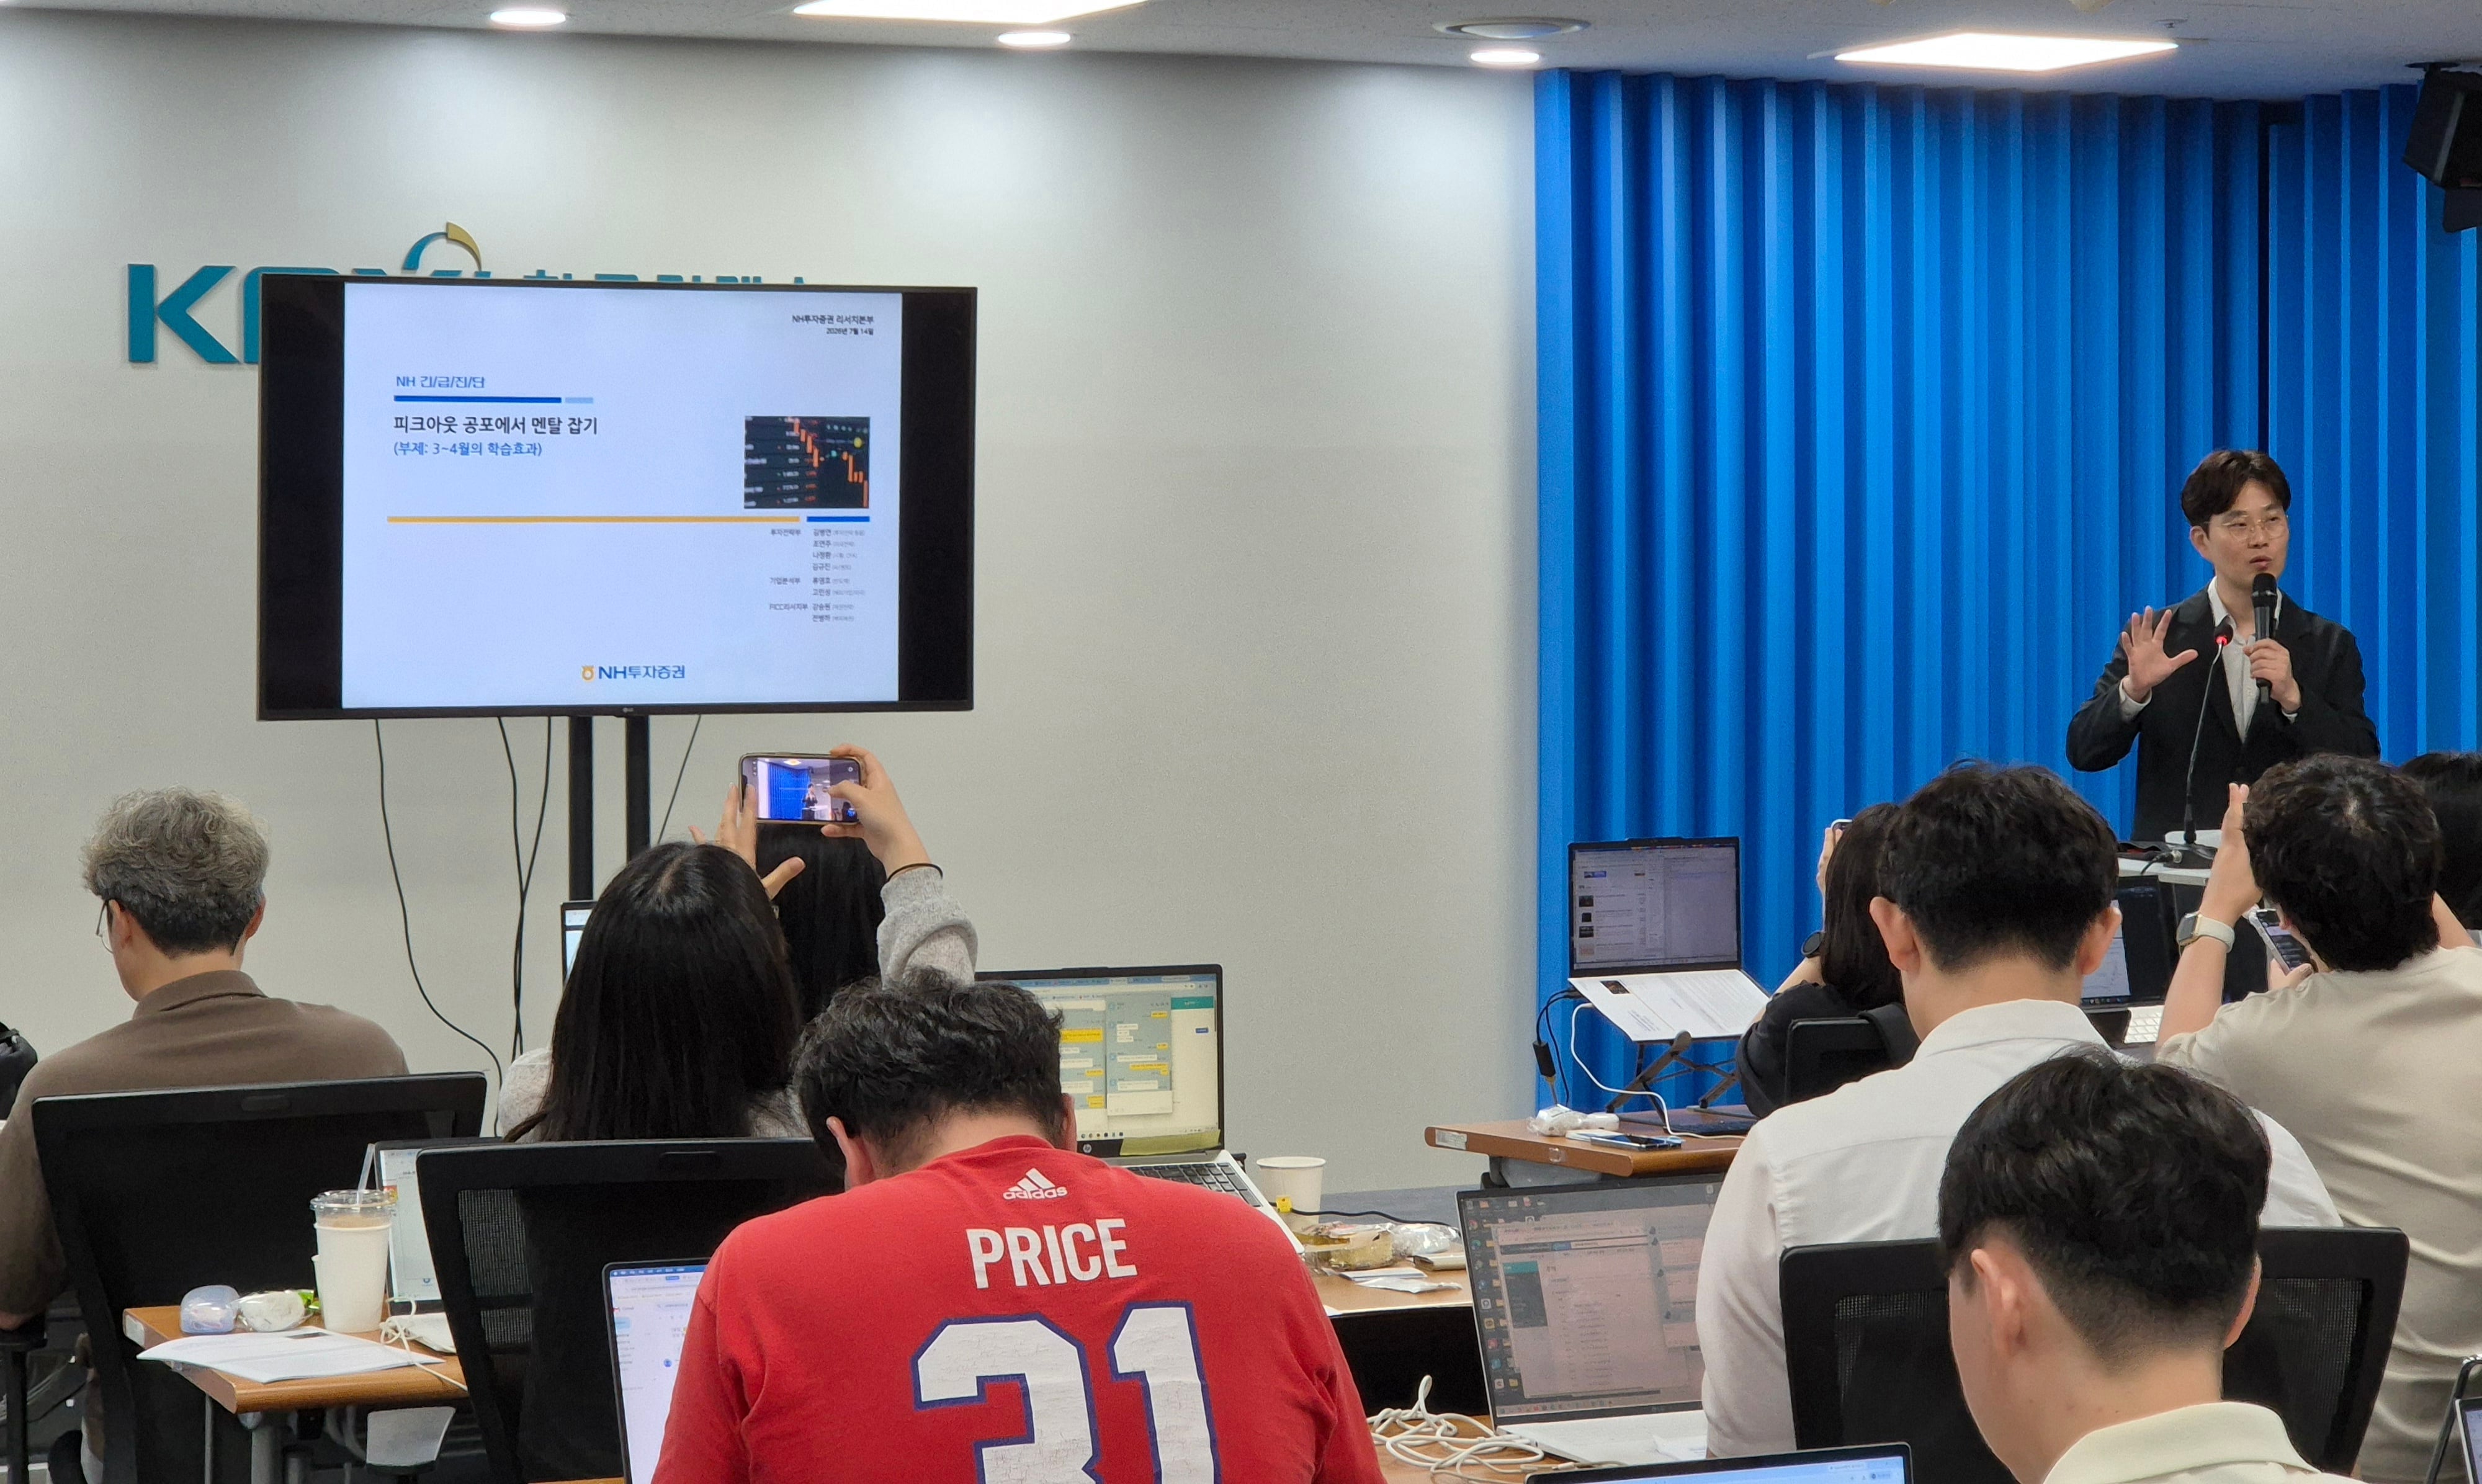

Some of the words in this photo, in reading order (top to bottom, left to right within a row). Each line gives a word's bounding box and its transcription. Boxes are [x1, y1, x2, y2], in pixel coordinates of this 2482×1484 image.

[792, 315, 834, 324] NH투자증권
[396, 376, 415, 387] NH
[420, 376, 485, 388] 긴/급/진/단
[393, 416, 459, 434] 피크아웃
[462, 416, 526, 434] 공포에서
[531, 417, 563, 435] 멘탈
[567, 417, 598, 435] 잡기
[393, 442, 428, 456] (부제:
[432, 442, 483, 456] 3~4월의
[487, 442, 543, 456] 학습효과)
[598, 664, 686, 680] NH투자증권
[1002, 1186, 1068, 1200] adidas
[965, 1218, 1138, 1289] PRICE
[910, 1300, 1222, 1484] 31
